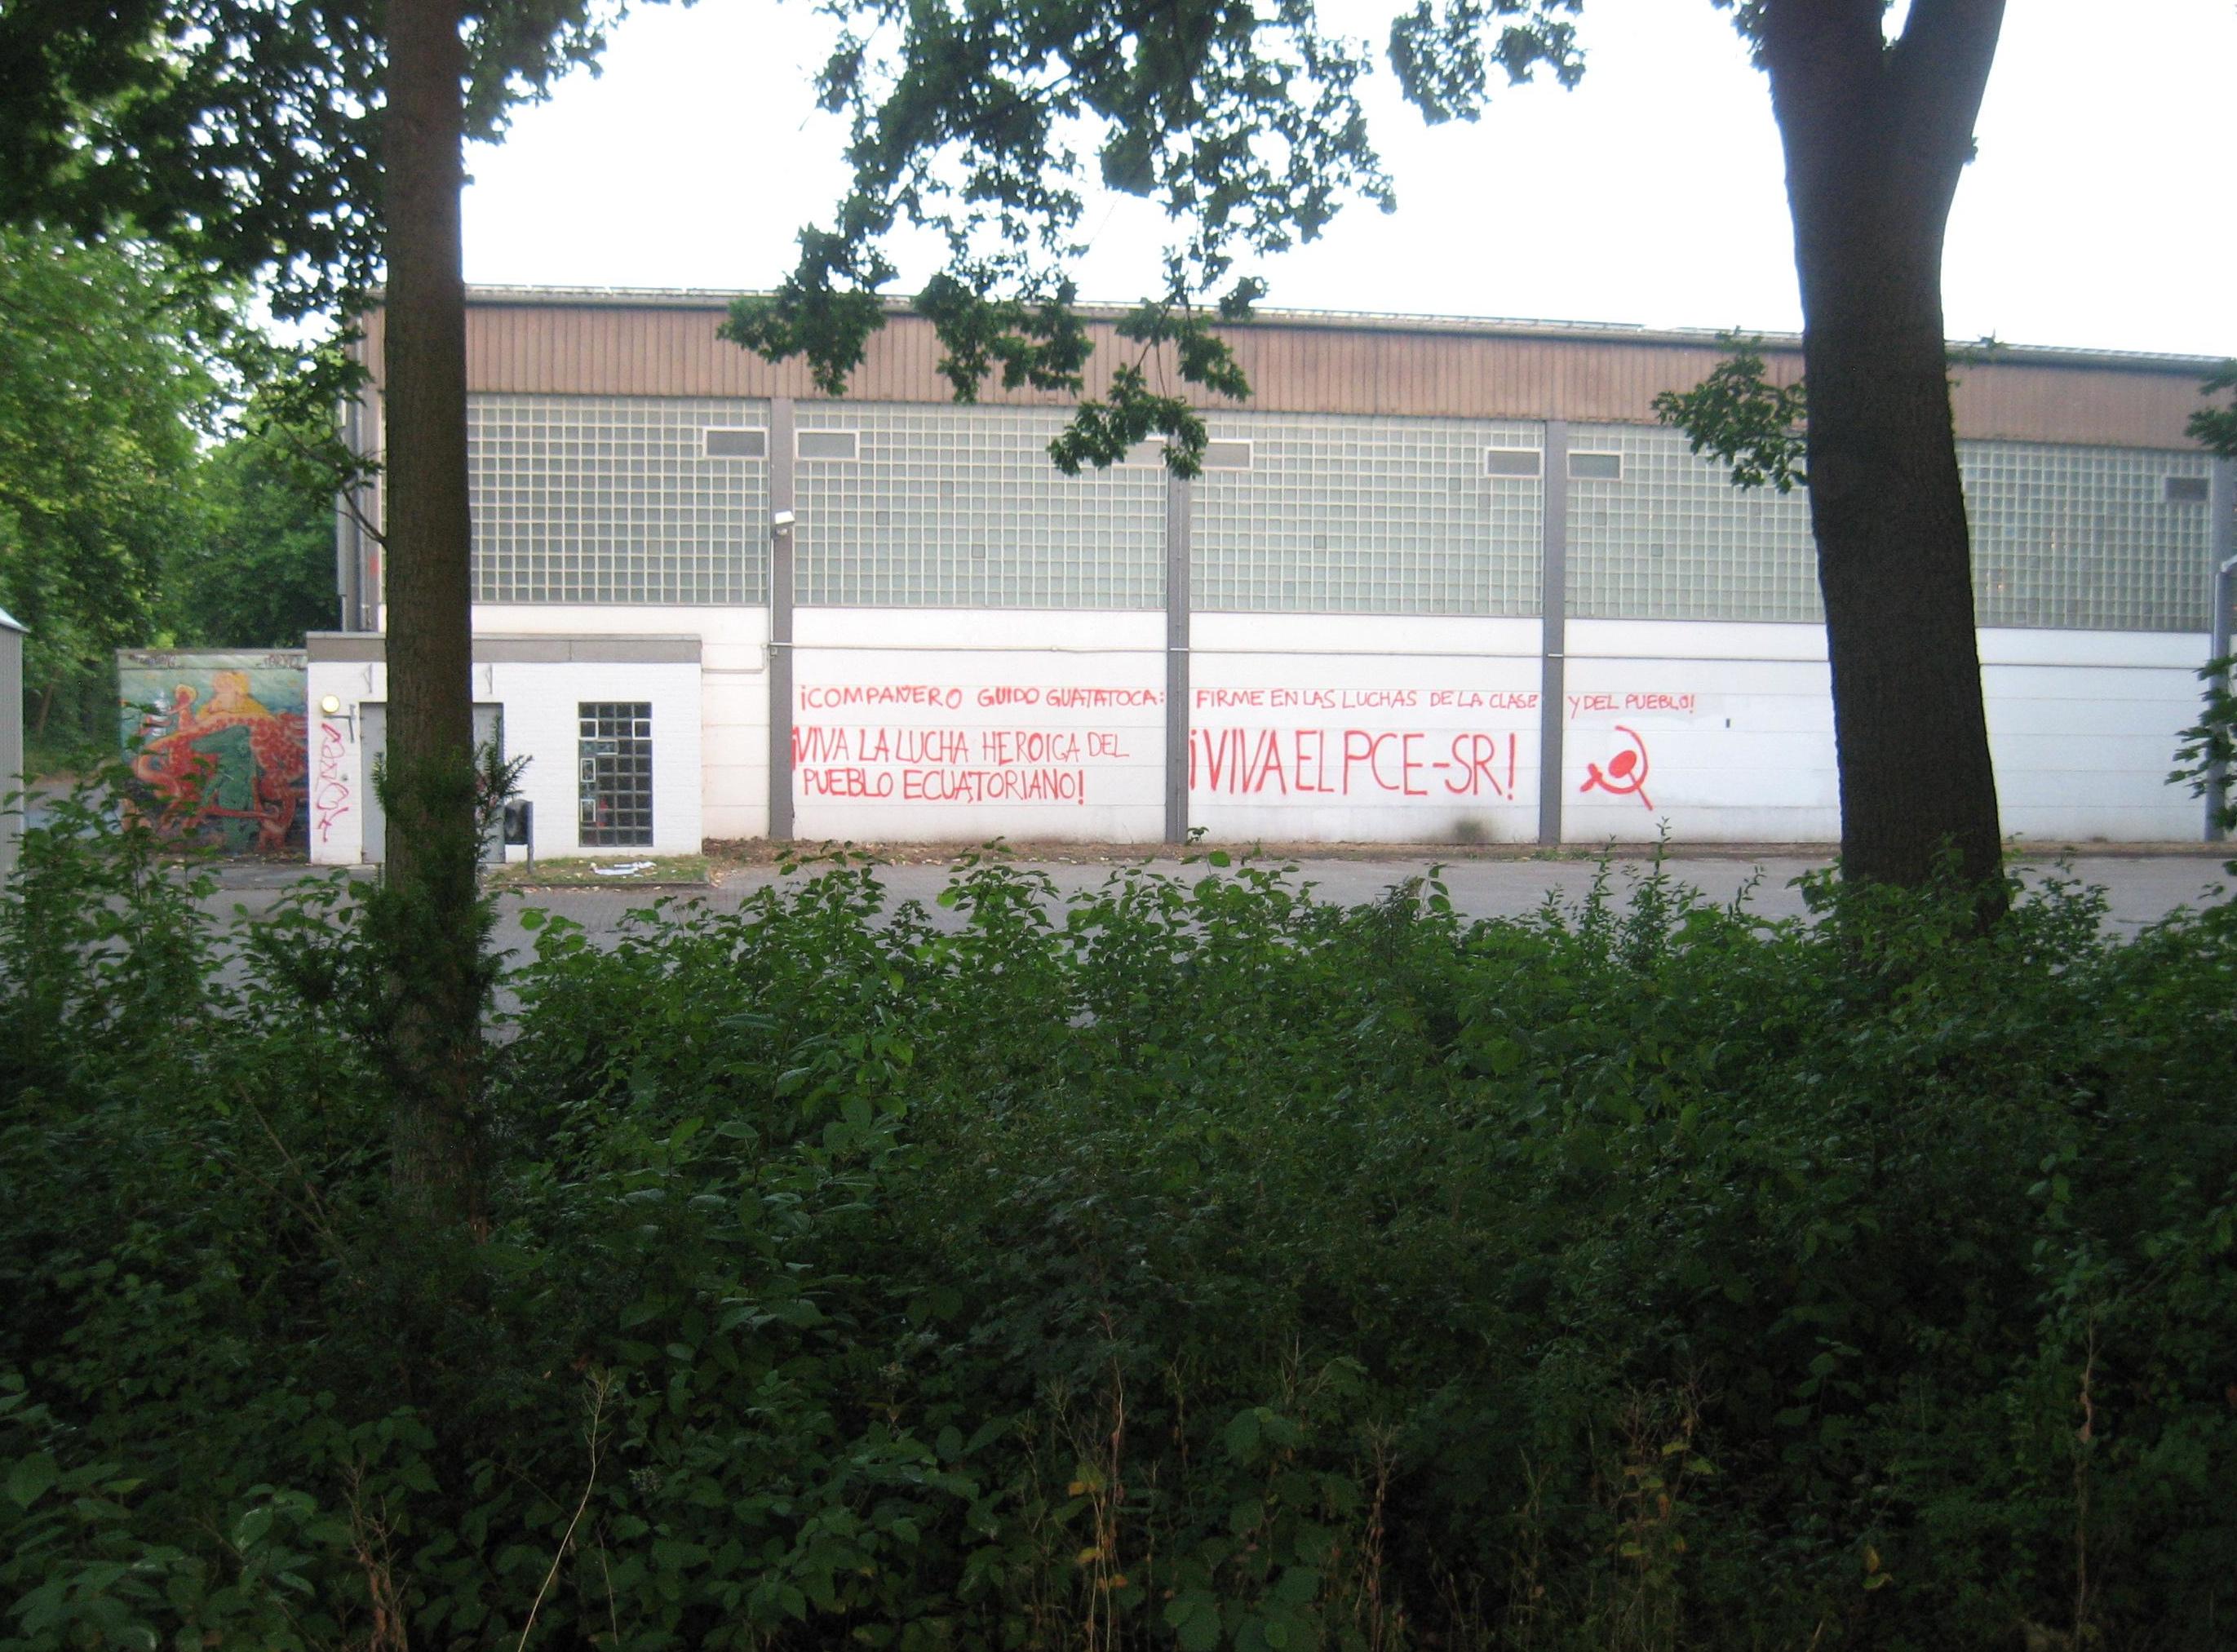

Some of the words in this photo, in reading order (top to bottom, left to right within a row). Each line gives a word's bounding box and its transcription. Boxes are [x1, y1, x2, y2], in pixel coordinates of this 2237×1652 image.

[977, 687, 1040, 707] GUIDO
[1046, 688, 1166, 707] GUATATOCA:
[1196, 689, 1265, 708] FIRME
[1271, 689, 1298, 707] EN
[1303, 689, 1336, 709] LAS
[1342, 690, 1416, 709] LUCHAS
[1430, 691, 1452, 706] DE
[1457, 693, 1483, 707] LA
[1489, 693, 1539, 709] CLASE
[1568, 695, 1580, 719] Y
[1584, 695, 1619, 711] DEL
[1625, 693, 1694, 713] PUEBLO!
[791, 725, 850, 770] ¡VIVA
[858, 727, 891, 762] LA
[896, 729, 970, 764] LUCHA
[981, 730, 1081, 765] HEROICA
[1087, 731, 1129, 758] DEL
[1189, 729, 1287, 795] ¡VIVA
[1295, 729, 1336, 794] EL
[1343, 729, 1517, 800] PCE-SR!
[803, 768, 894, 798] PUEBLO
[902, 768, 1086, 805] ECUATORIANO!
